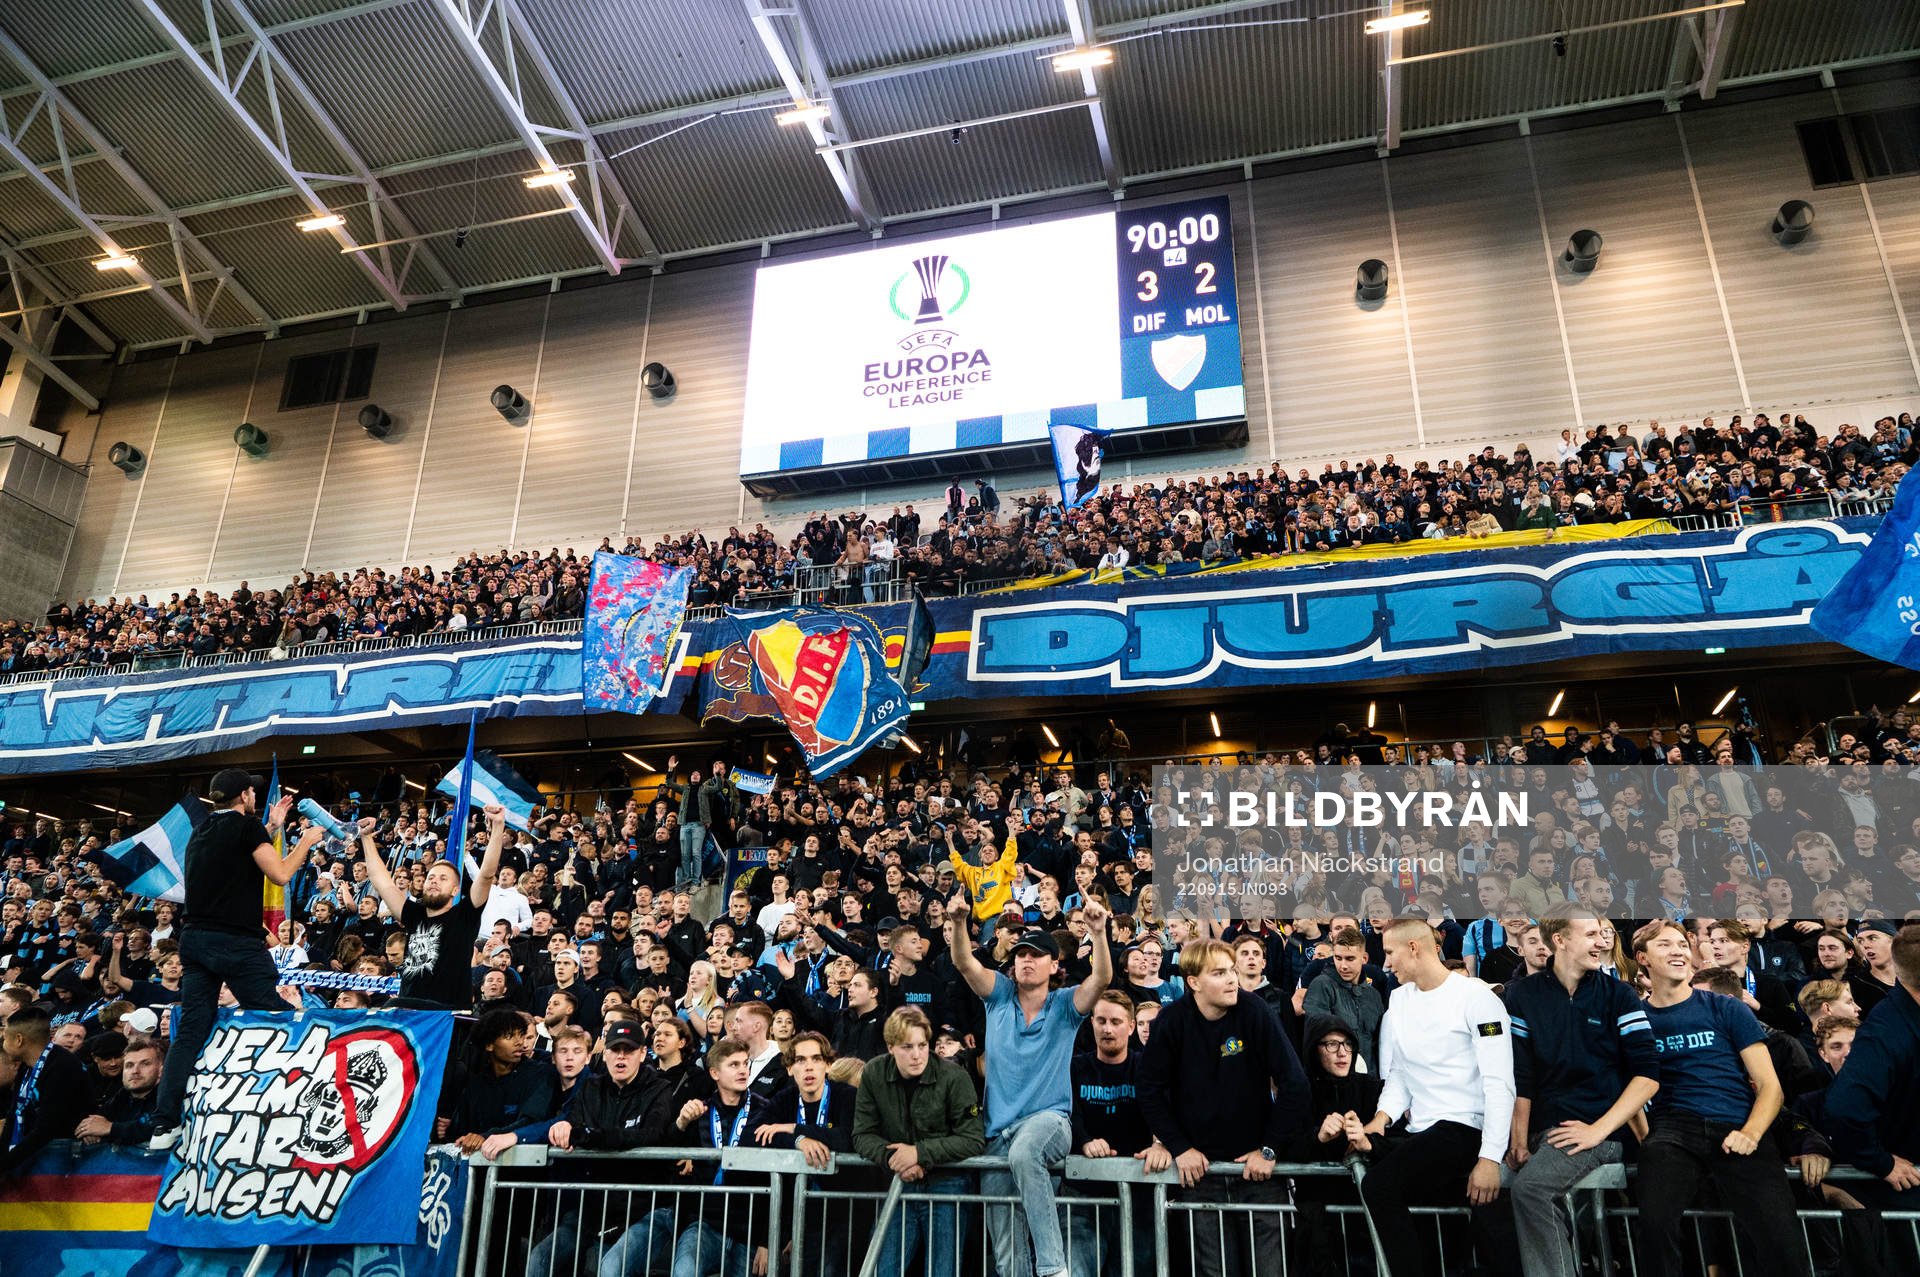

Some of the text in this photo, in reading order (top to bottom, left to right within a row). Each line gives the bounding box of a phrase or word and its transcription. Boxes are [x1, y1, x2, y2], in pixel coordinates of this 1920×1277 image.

[1127, 213, 1220, 253] 90:00
[1165, 250, 1183, 264] +4
[1137, 261, 1217, 302] 3 2
[1133, 304, 1231, 333] DIF MOL
[901, 333, 953, 351] UEFA
[864, 348, 991, 383] EUROPA
[862, 369, 992, 397] CONFERENCE
[888, 388, 964, 409] LEAGUE
[194, 1025, 330, 1077] HELA
[1686, 1030, 1715, 1049] DIF
